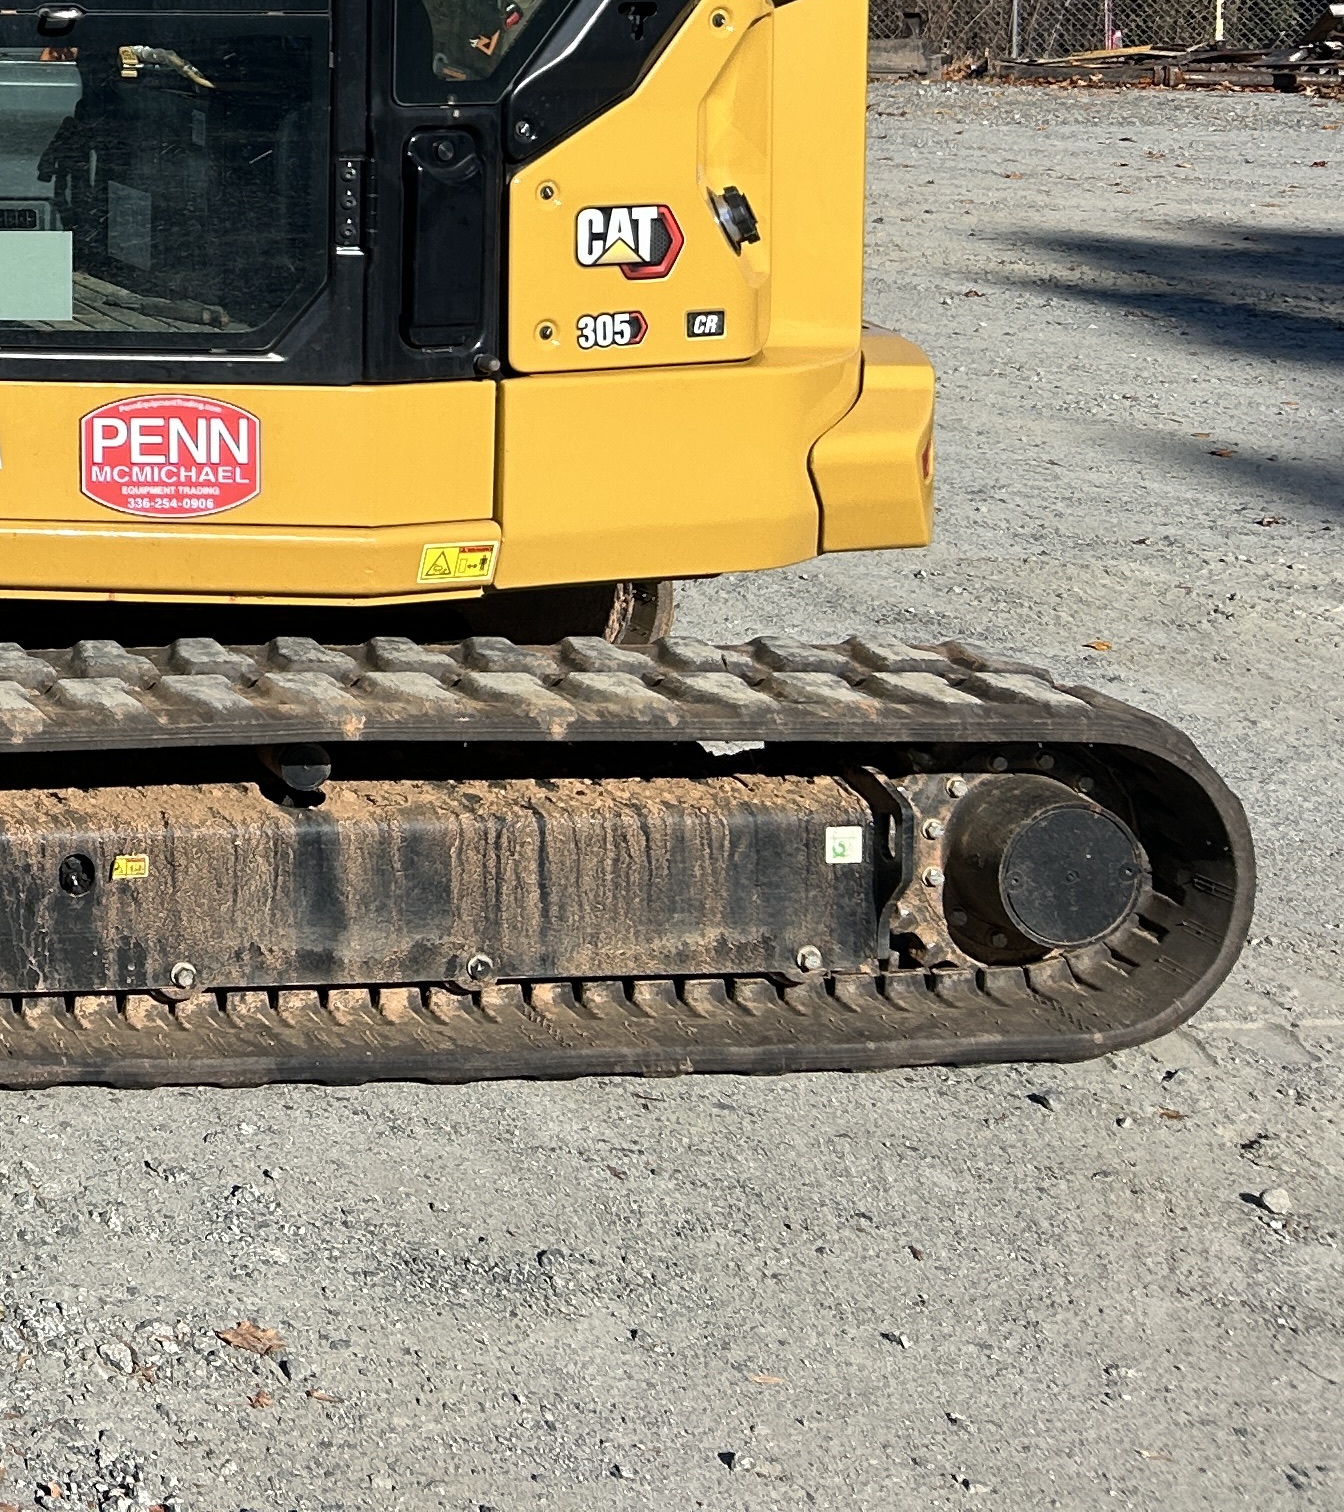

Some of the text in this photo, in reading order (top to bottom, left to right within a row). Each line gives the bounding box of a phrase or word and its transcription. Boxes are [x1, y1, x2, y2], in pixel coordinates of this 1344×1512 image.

[577, 206, 658, 265] CAT
[577, 313, 631, 348] 305
[693, 315, 719, 334] CR
[92, 418, 249, 464] PENN
[91, 466, 250, 483] MCMICHAEL
[122, 486, 220, 495] EQUIPMENT TRADING
[128, 498, 215, 509] 336-254-0906
